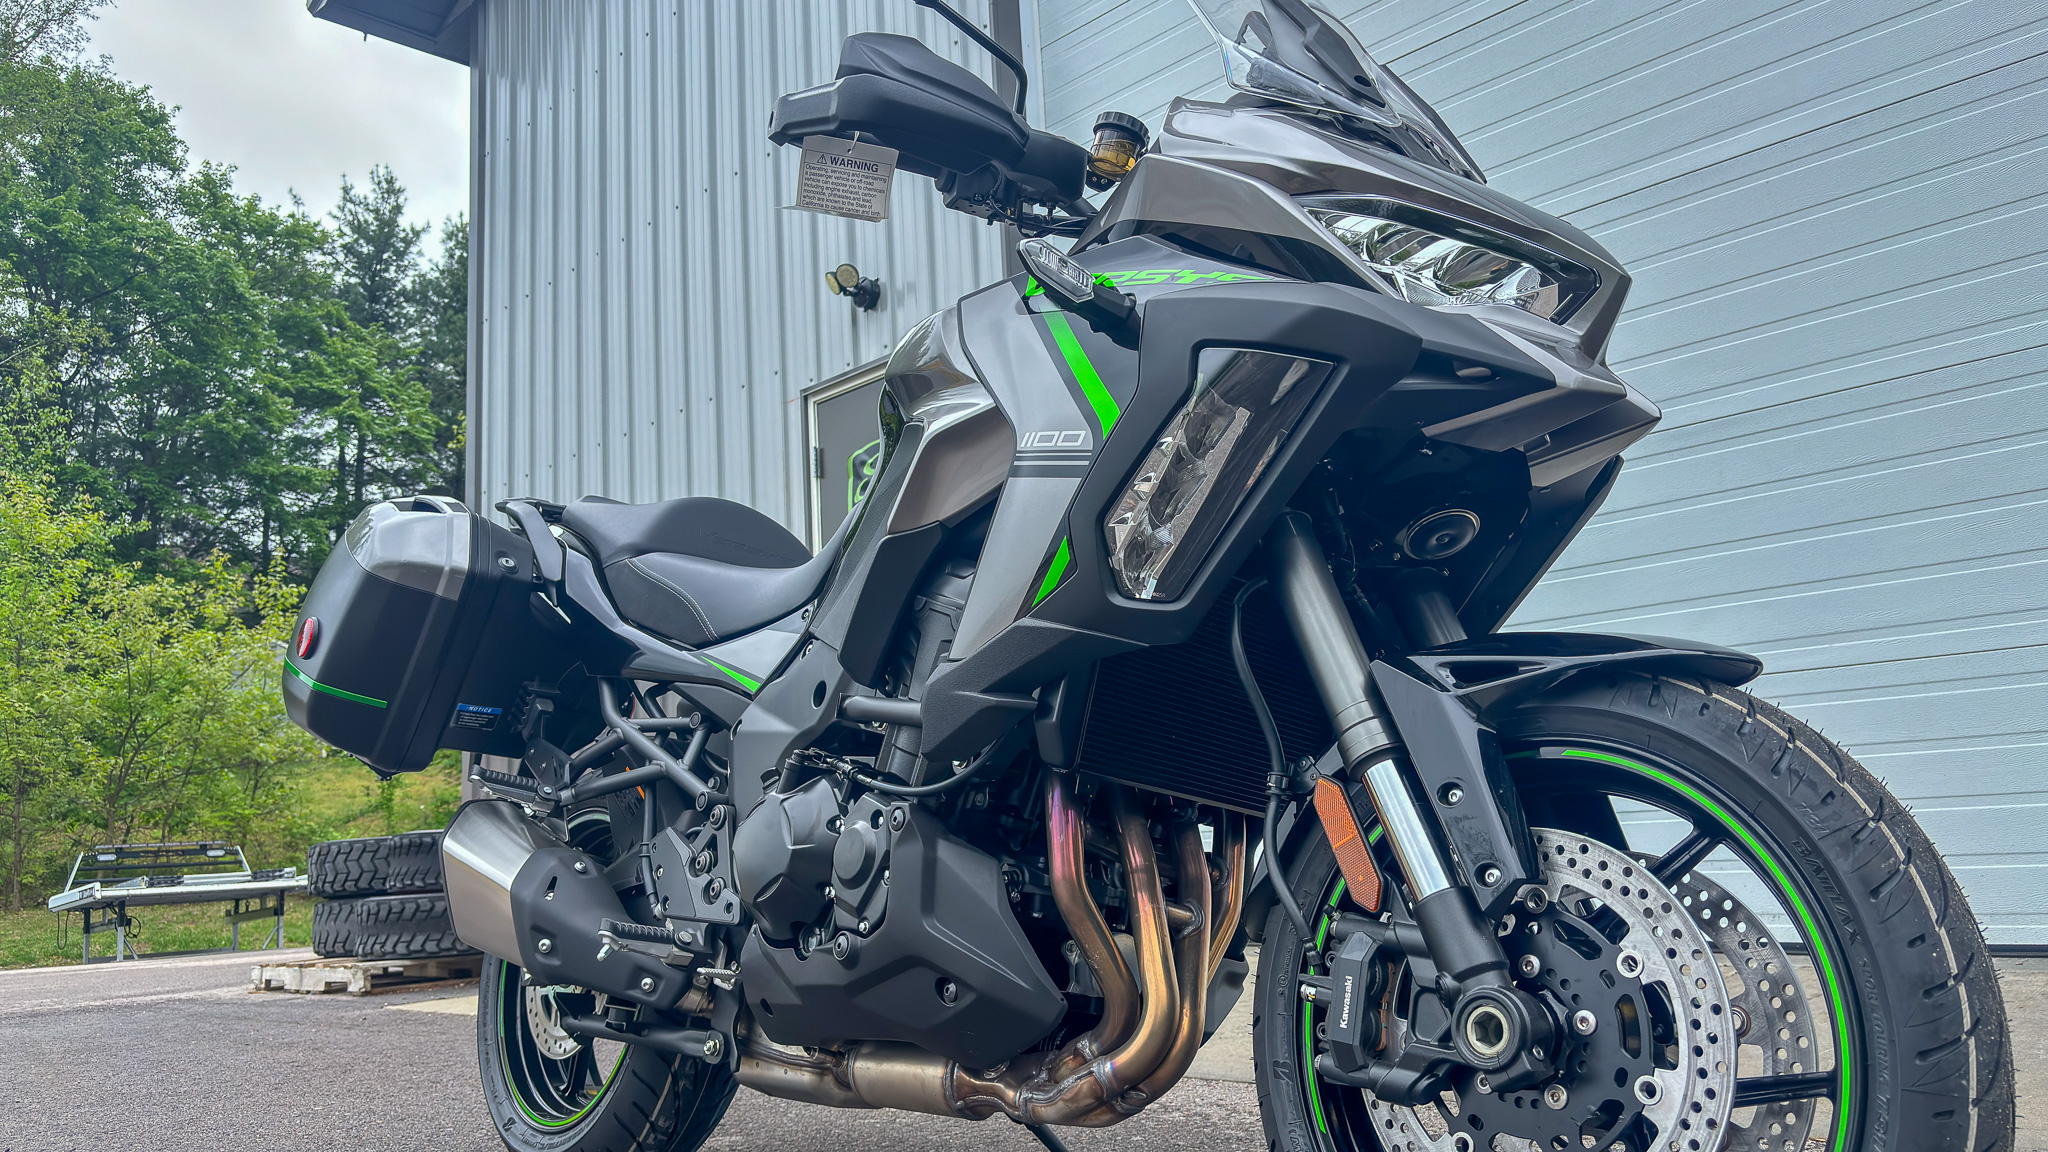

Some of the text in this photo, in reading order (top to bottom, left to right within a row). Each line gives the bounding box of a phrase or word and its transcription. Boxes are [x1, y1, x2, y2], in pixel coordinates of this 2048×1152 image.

[830, 156, 879, 172] WARNING
[806, 164, 829, 174] Operating,
[830, 169, 850, 177] servicing
[861, 174, 887, 183] maintaining
[803, 188, 827, 197] monoxide,
[804, 182, 824, 191] including
[842, 188, 860, 196] exhaust,
[863, 185, 885, 194] chemicals
[802, 200, 824, 208] California
[1020, 430, 1087, 448] 1100
[1791, 837, 1864, 945] BATTLAX
[1339, 975, 1353, 1029] Kawasaki
